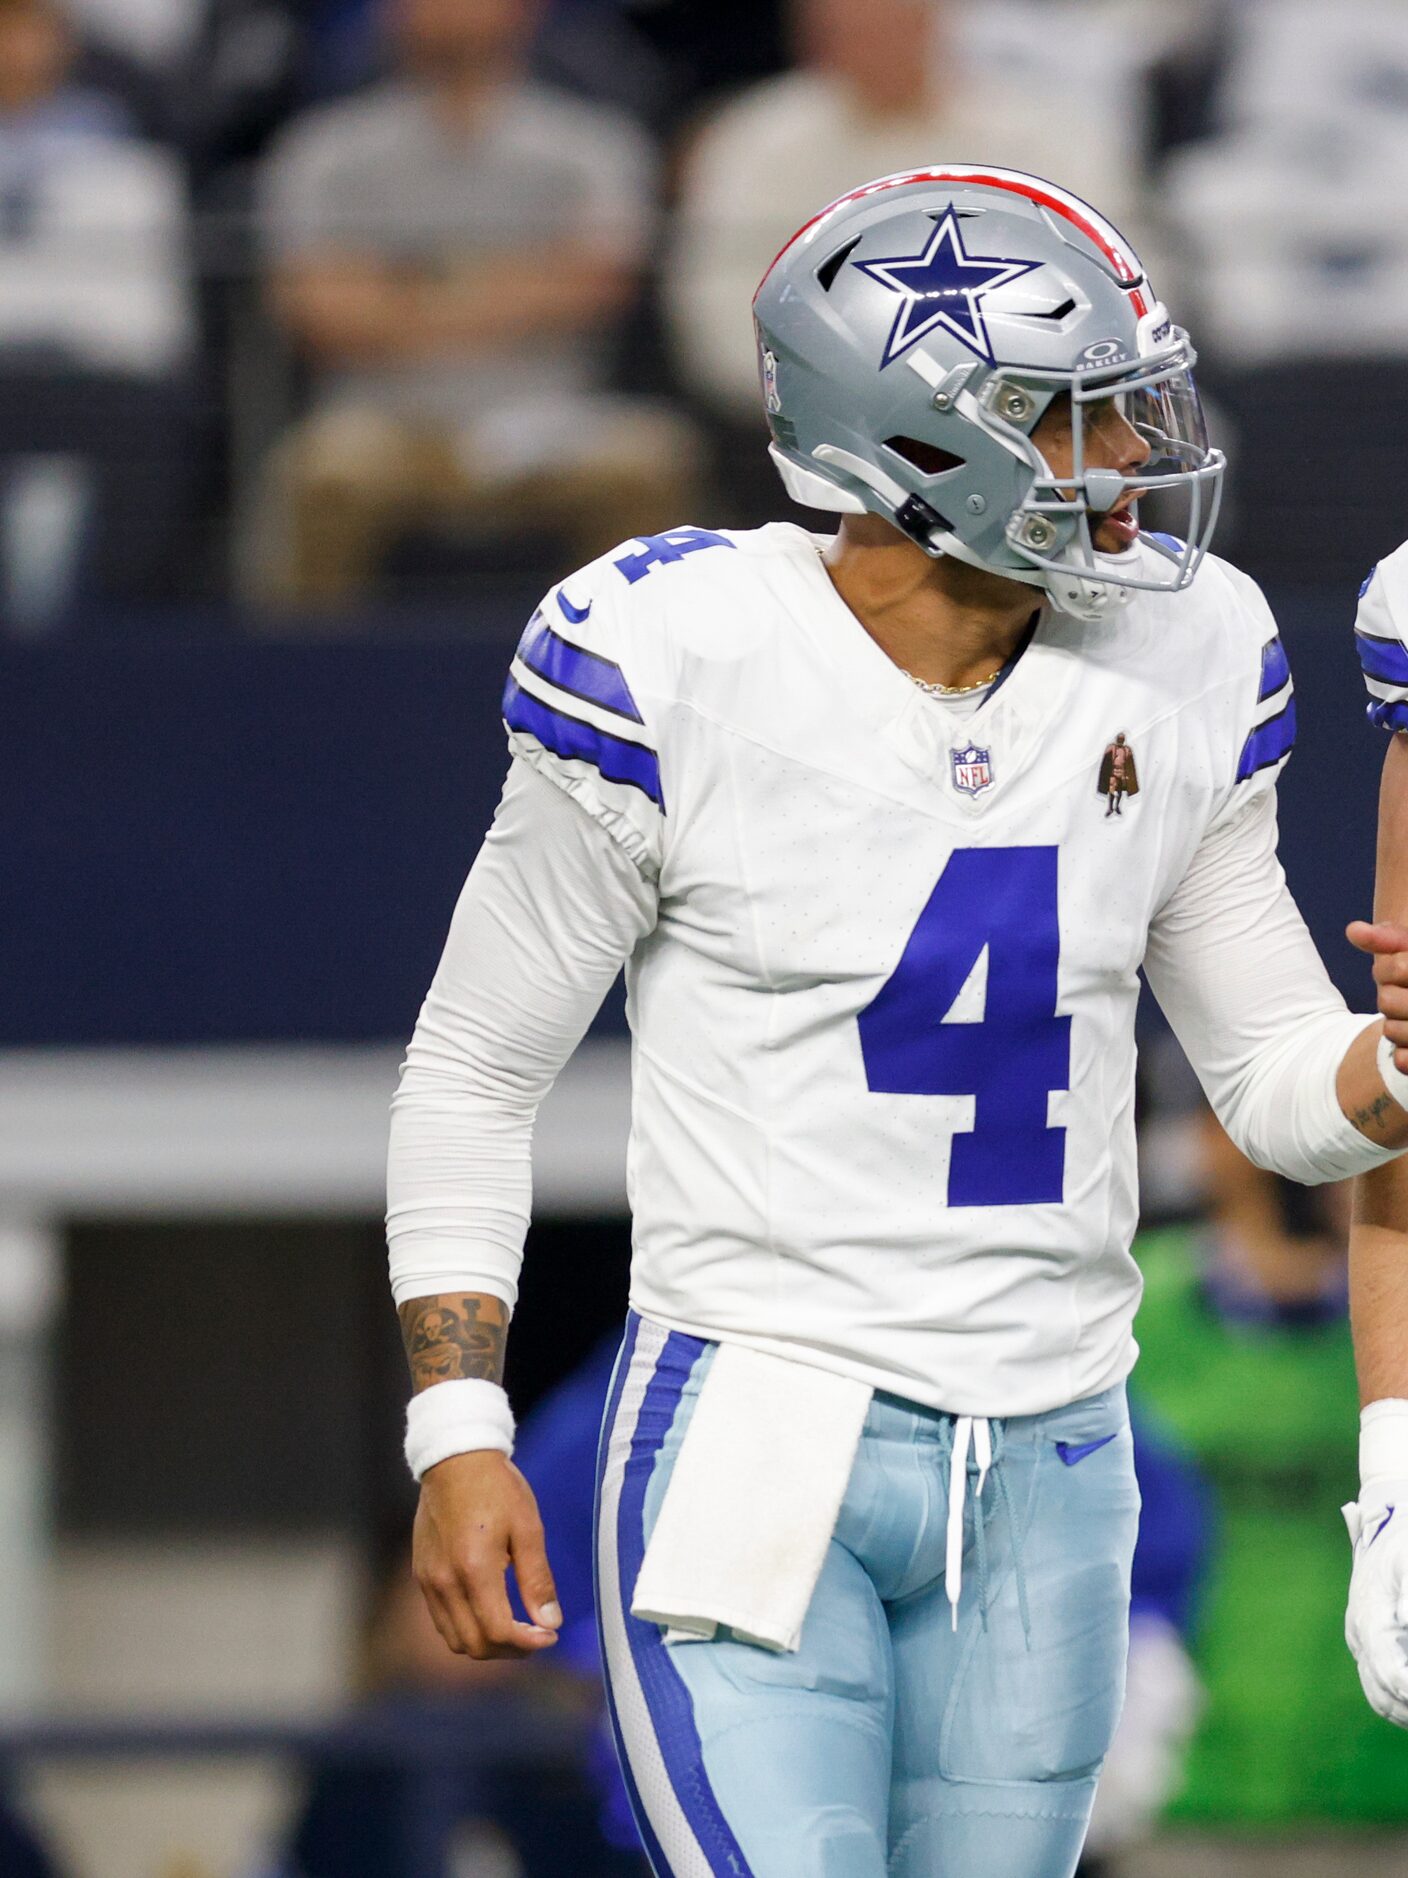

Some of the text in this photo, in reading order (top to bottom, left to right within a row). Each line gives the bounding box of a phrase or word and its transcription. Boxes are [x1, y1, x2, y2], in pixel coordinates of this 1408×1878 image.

[1076, 353, 1127, 371] OAKLEY
[613, 530, 737, 585] 4
[959, 766, 989, 788] NFL
[857, 845, 1073, 1207] 4
